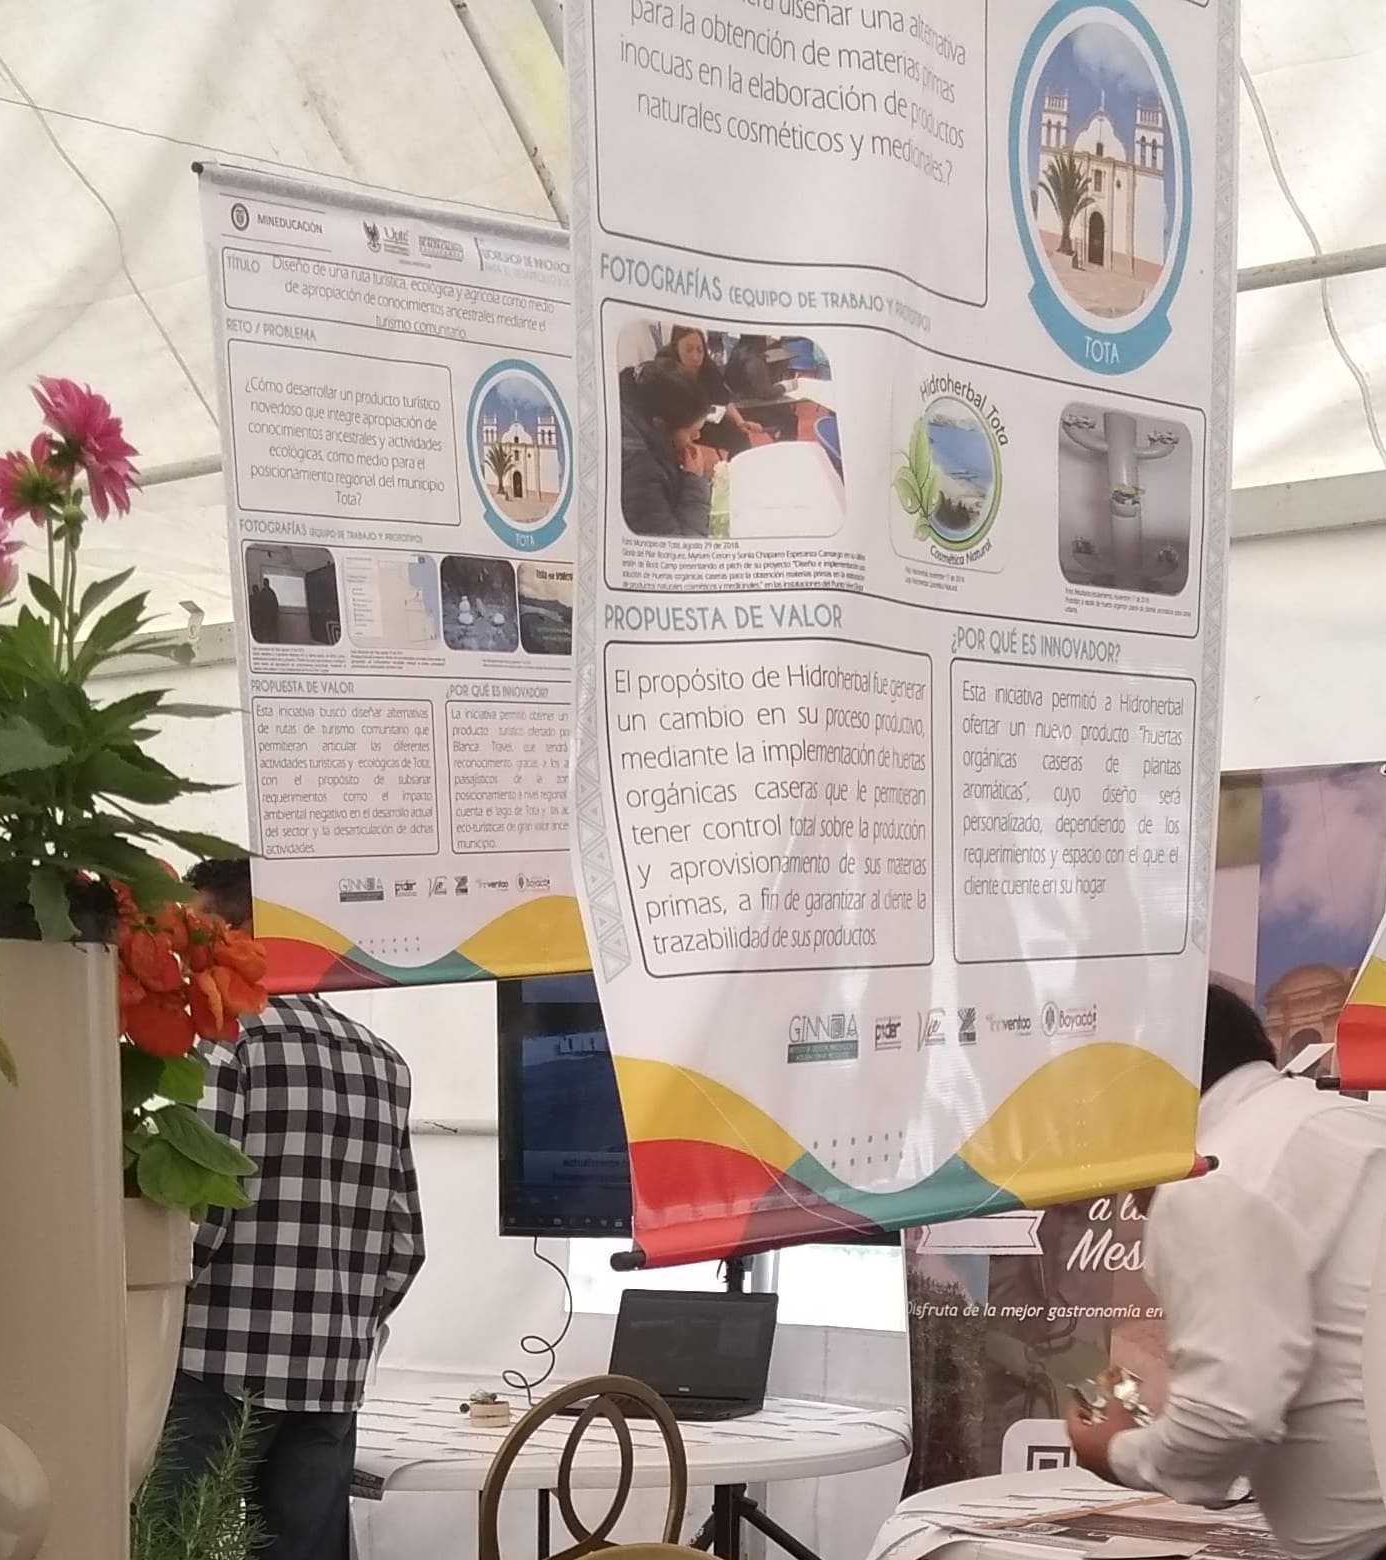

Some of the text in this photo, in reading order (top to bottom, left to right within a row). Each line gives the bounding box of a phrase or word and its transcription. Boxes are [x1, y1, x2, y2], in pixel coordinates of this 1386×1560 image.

[632, 0, 919, 81] para la obtención de materias
[621, 41, 692, 80] inocuas
[699, 63, 722, 88] en
[728, 64, 742, 93] la
[748, 73, 876, 112] elaboración
[884, 90, 907, 118] de
[257, 214, 323, 234] MINEDUCACIÓN
[227, 254, 260, 273] TÍTULO
[601, 255, 884, 312] FOTOGRAFÍAS (EQUIPO DE TRABAJO
[226, 317, 252, 333] RETO
[263, 322, 316, 341] PROBLEMA
[1085, 335, 1120, 364] TOTA
[919, 373, 1009, 446] Hidroherbal Tota
[239, 518, 311, 536] FOTOGRAFÍAS
[515, 532, 534, 546] TOTA
[930, 538, 993, 566] Cosmética Natural
[605, 603, 841, 631] PROPUESTA DE VALOR
[951, 626, 1120, 663] ¿POR QUÉ ES INNOVADOR?
[250, 679, 354, 694] PROPUESTA DE VALOR
[615, 669, 630, 693] El
[638, 668, 743, 699] propósito
[752, 666, 779, 688] de
[787, 664, 870, 692] Hidroherbal
[963, 680, 1183, 715] Esta iniciativa permitió a Hidroherbal
[1089, 1198, 1112, 1221] a
[1066, 1227, 1147, 1271] Mes
[963, 1298, 979, 1316] de
[983, 1298, 996, 1317] la
[1001, 1304, 1044, 1320] mejor
[1046, 1304, 1140, 1321] gastronomía
[1145, 1308, 1163, 1318] en
